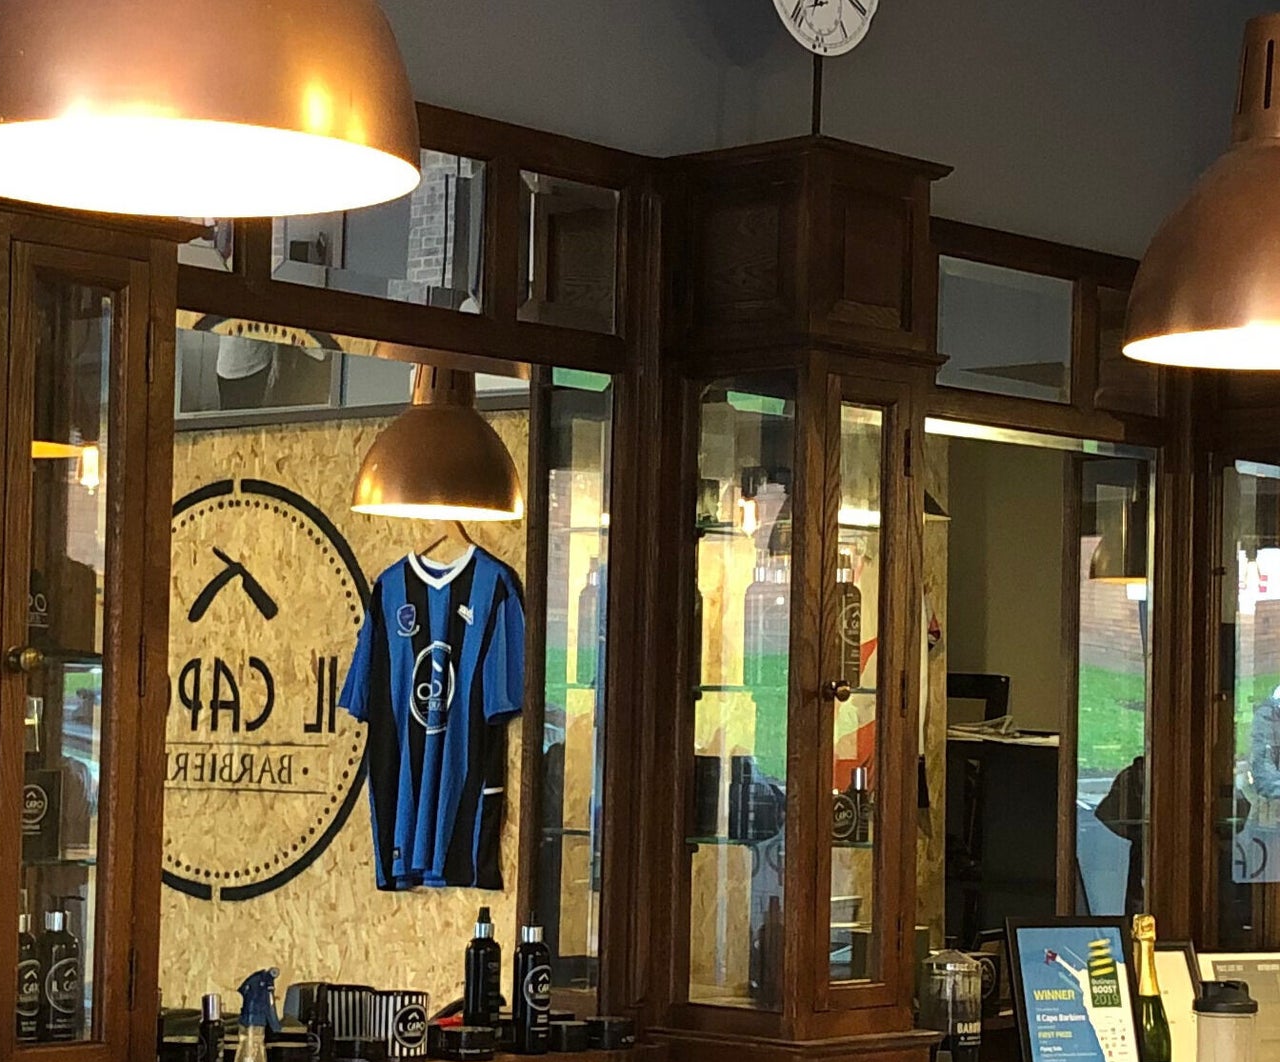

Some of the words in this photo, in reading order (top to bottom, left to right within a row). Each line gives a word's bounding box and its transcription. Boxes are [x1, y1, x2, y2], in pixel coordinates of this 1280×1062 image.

[1033, 989, 1075, 1001] WINNER
[1092, 985, 1117, 994] BOOST
[1094, 994, 1119, 1005] 2019
